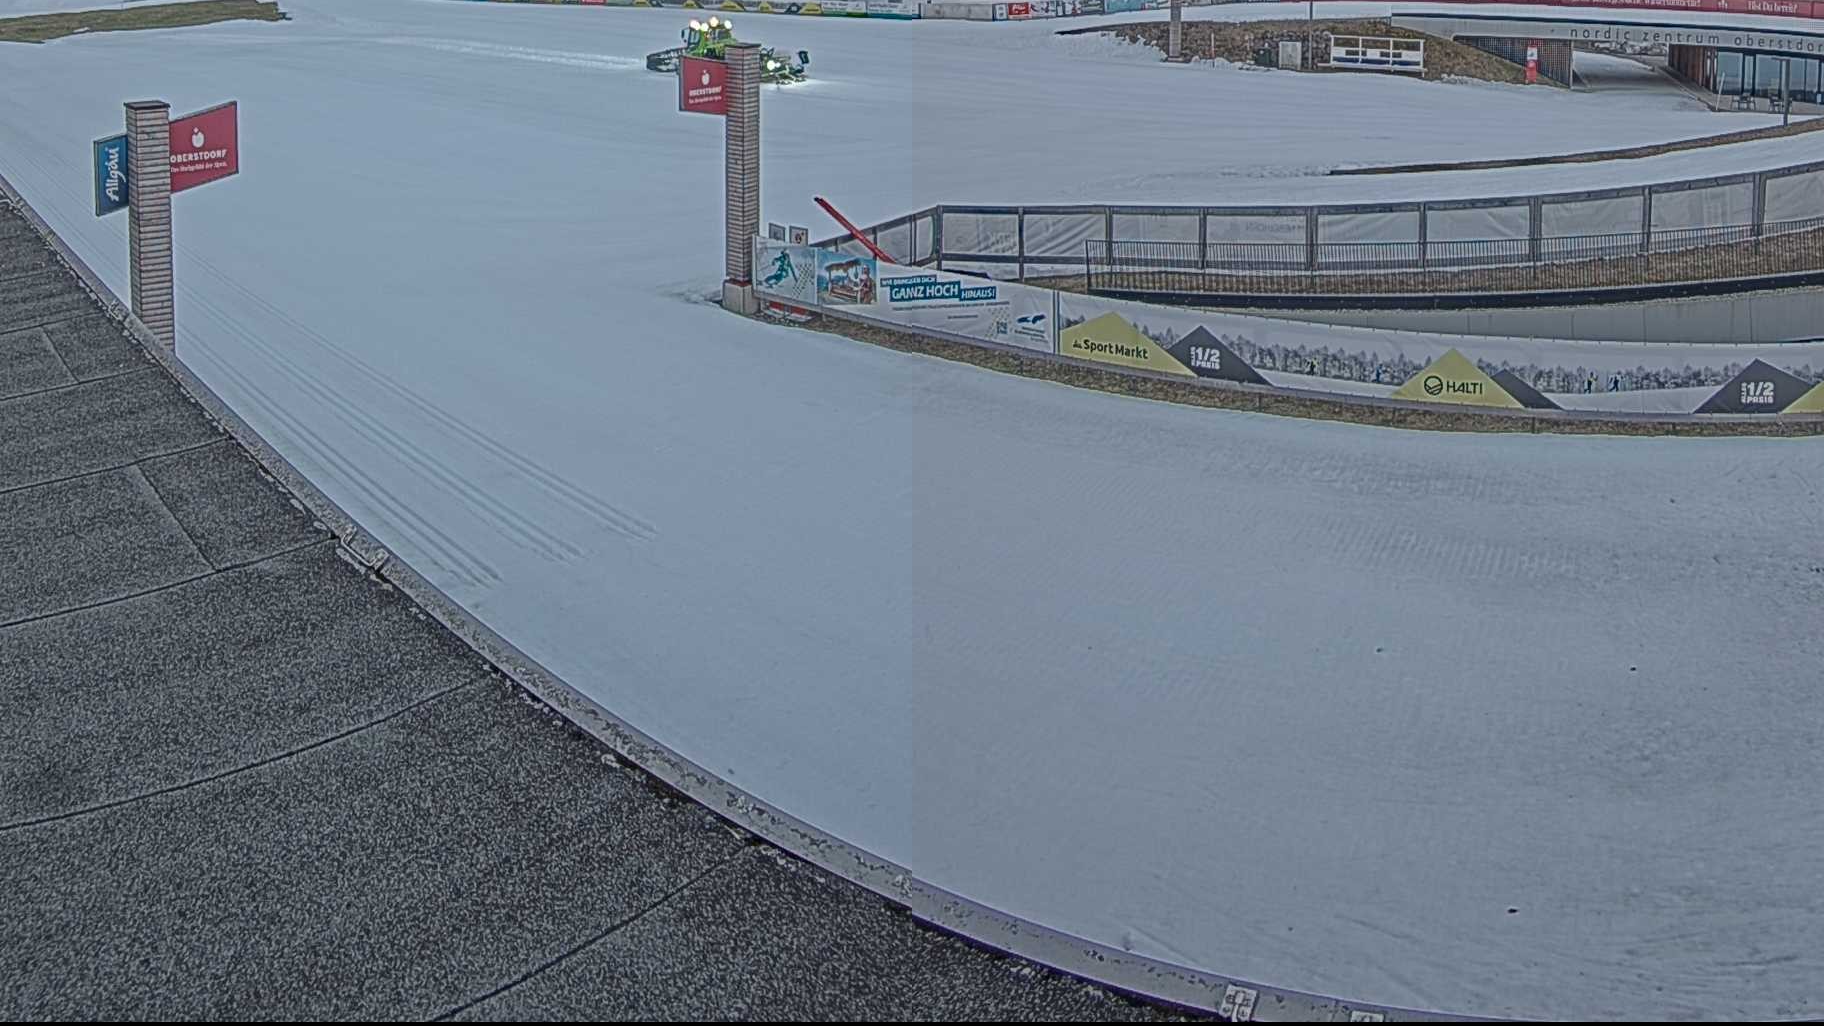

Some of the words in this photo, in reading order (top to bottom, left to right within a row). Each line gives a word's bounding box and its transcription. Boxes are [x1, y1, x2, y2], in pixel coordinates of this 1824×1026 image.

[1570, 27, 1630, 40] nordic
[1643, 32, 1720, 44] zentrum
[170, 149, 227, 163] OBERSTDORF
[892, 285, 924, 300] GANZ
[926, 284, 959, 298] HOCH
[1083, 339, 1114, 354] Sport
[1115, 343, 1148, 360] Markt
[1196, 346, 1220, 363] 1/2
[1446, 380, 1483, 394] HALTI
[1747, 381, 1774, 396] 1/2
